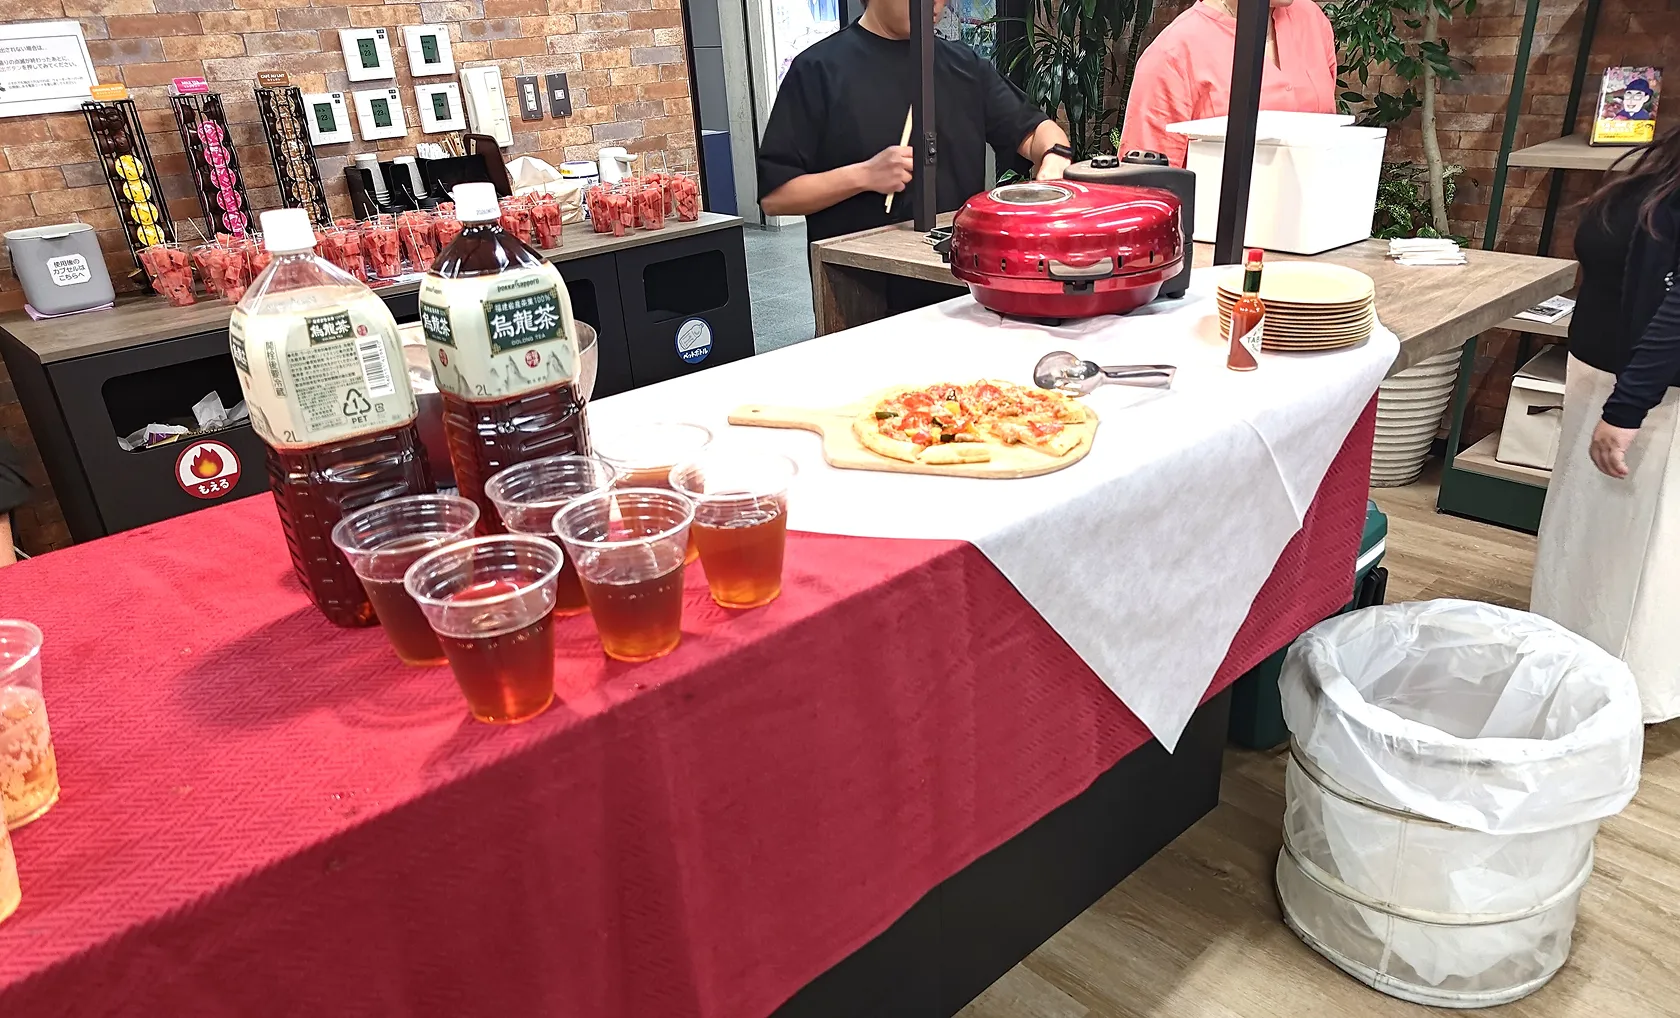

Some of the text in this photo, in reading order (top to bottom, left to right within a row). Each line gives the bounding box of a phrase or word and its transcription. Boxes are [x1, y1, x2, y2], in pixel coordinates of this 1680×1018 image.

[53, 259, 80, 268] 使用後の
[53, 265, 85, 275] カプセルは
[59, 272, 85, 281] こちらへ
[422, 311, 451, 337] 烏龍茶
[490, 303, 560, 339] 烏龍茶
[310, 319, 350, 338] 烏龍茶
[475, 384, 492, 396] 2L
[351, 415, 368, 424] PET
[284, 430, 302, 443] 2L
[198, 478, 230, 495] もえる
